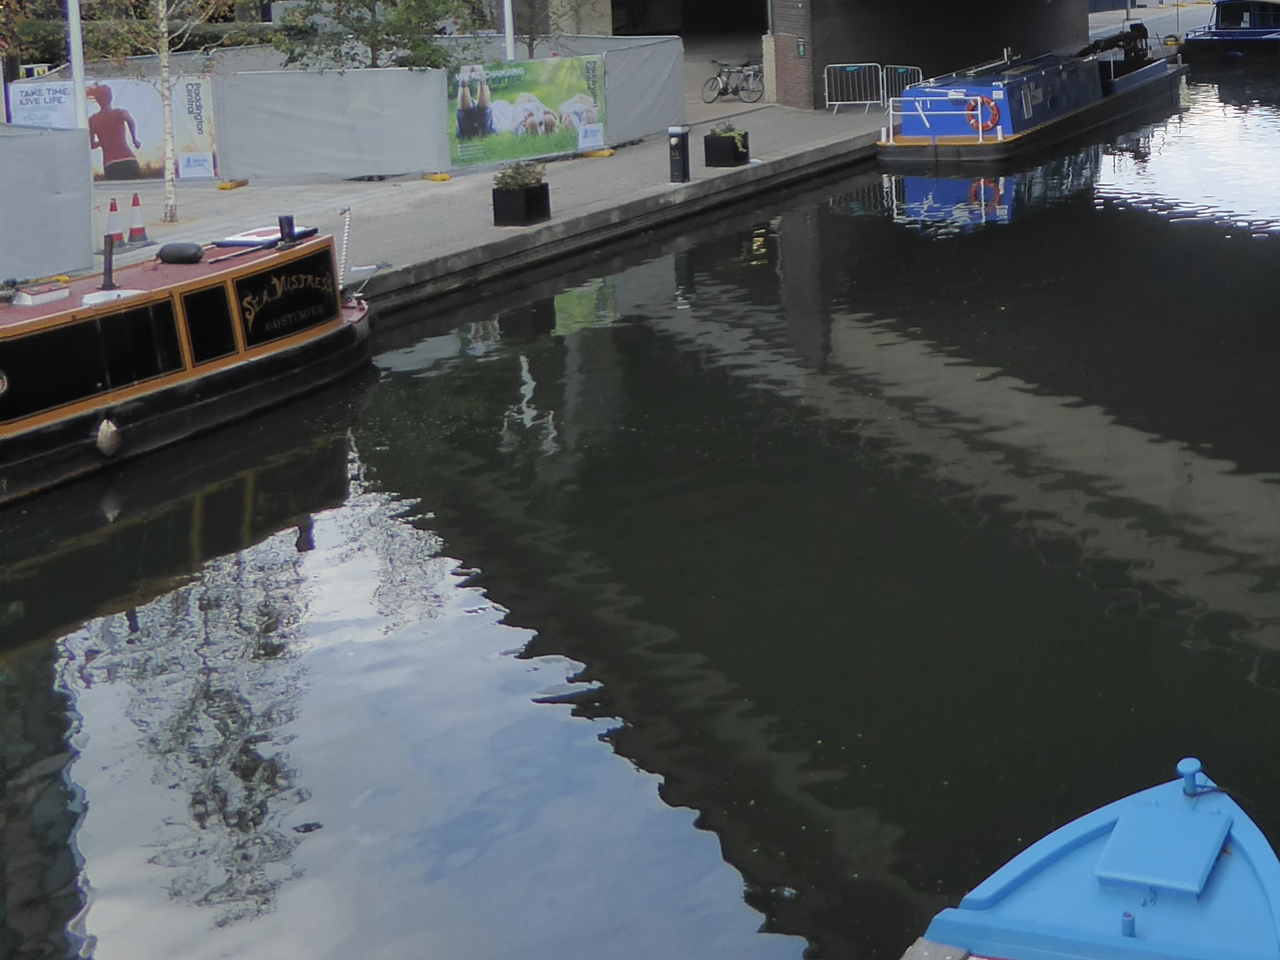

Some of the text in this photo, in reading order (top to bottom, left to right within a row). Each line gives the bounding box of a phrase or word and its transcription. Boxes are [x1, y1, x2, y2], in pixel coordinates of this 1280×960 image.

[20, 88, 71, 98] TAKE TIME.
[20, 98, 42, 106] LIVE
[186, 83, 194, 115] Central
[194, 83, 204, 135] Paddington
